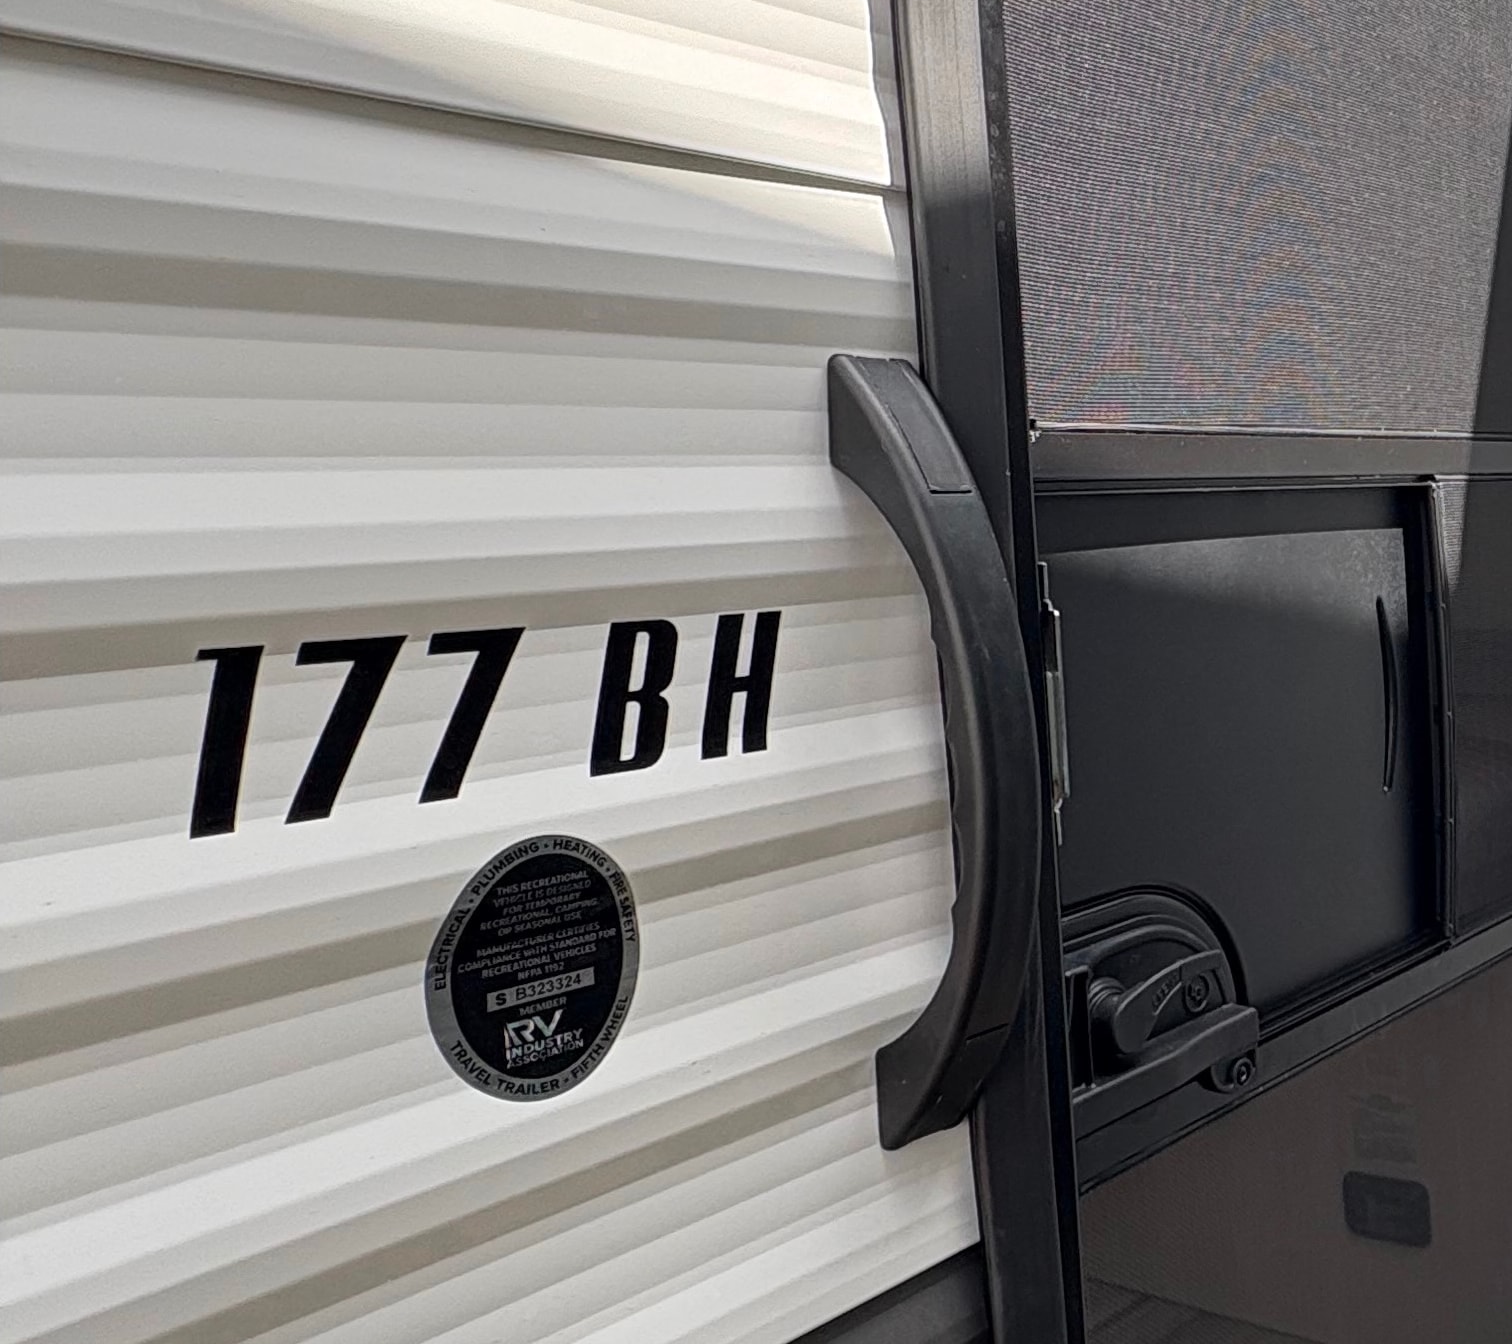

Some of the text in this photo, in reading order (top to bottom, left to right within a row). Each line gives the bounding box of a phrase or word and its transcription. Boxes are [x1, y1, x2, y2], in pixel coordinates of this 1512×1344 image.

[190, 610, 782, 839] 177 BH
[497, 870, 589, 896] THIS RECREATIONAL
[434, 839, 636, 990] ELECTRICAL PLUMBING HEATING FIRE SAFETY
[599, 927, 617, 938] FOR
[481, 943, 597, 979] RECREATIONAL VEHICLES
[495, 974, 582, 1006] S B323324
[520, 996, 567, 1016] MEMBER
[504, 1009, 564, 1046] RV
[450, 996, 629, 1095] TRAVEL TRAILER FIFTH WHEEL
[506, 1028, 583, 1060] INDUSTRY
[507, 1039, 584, 1069] ASSOCIATION
